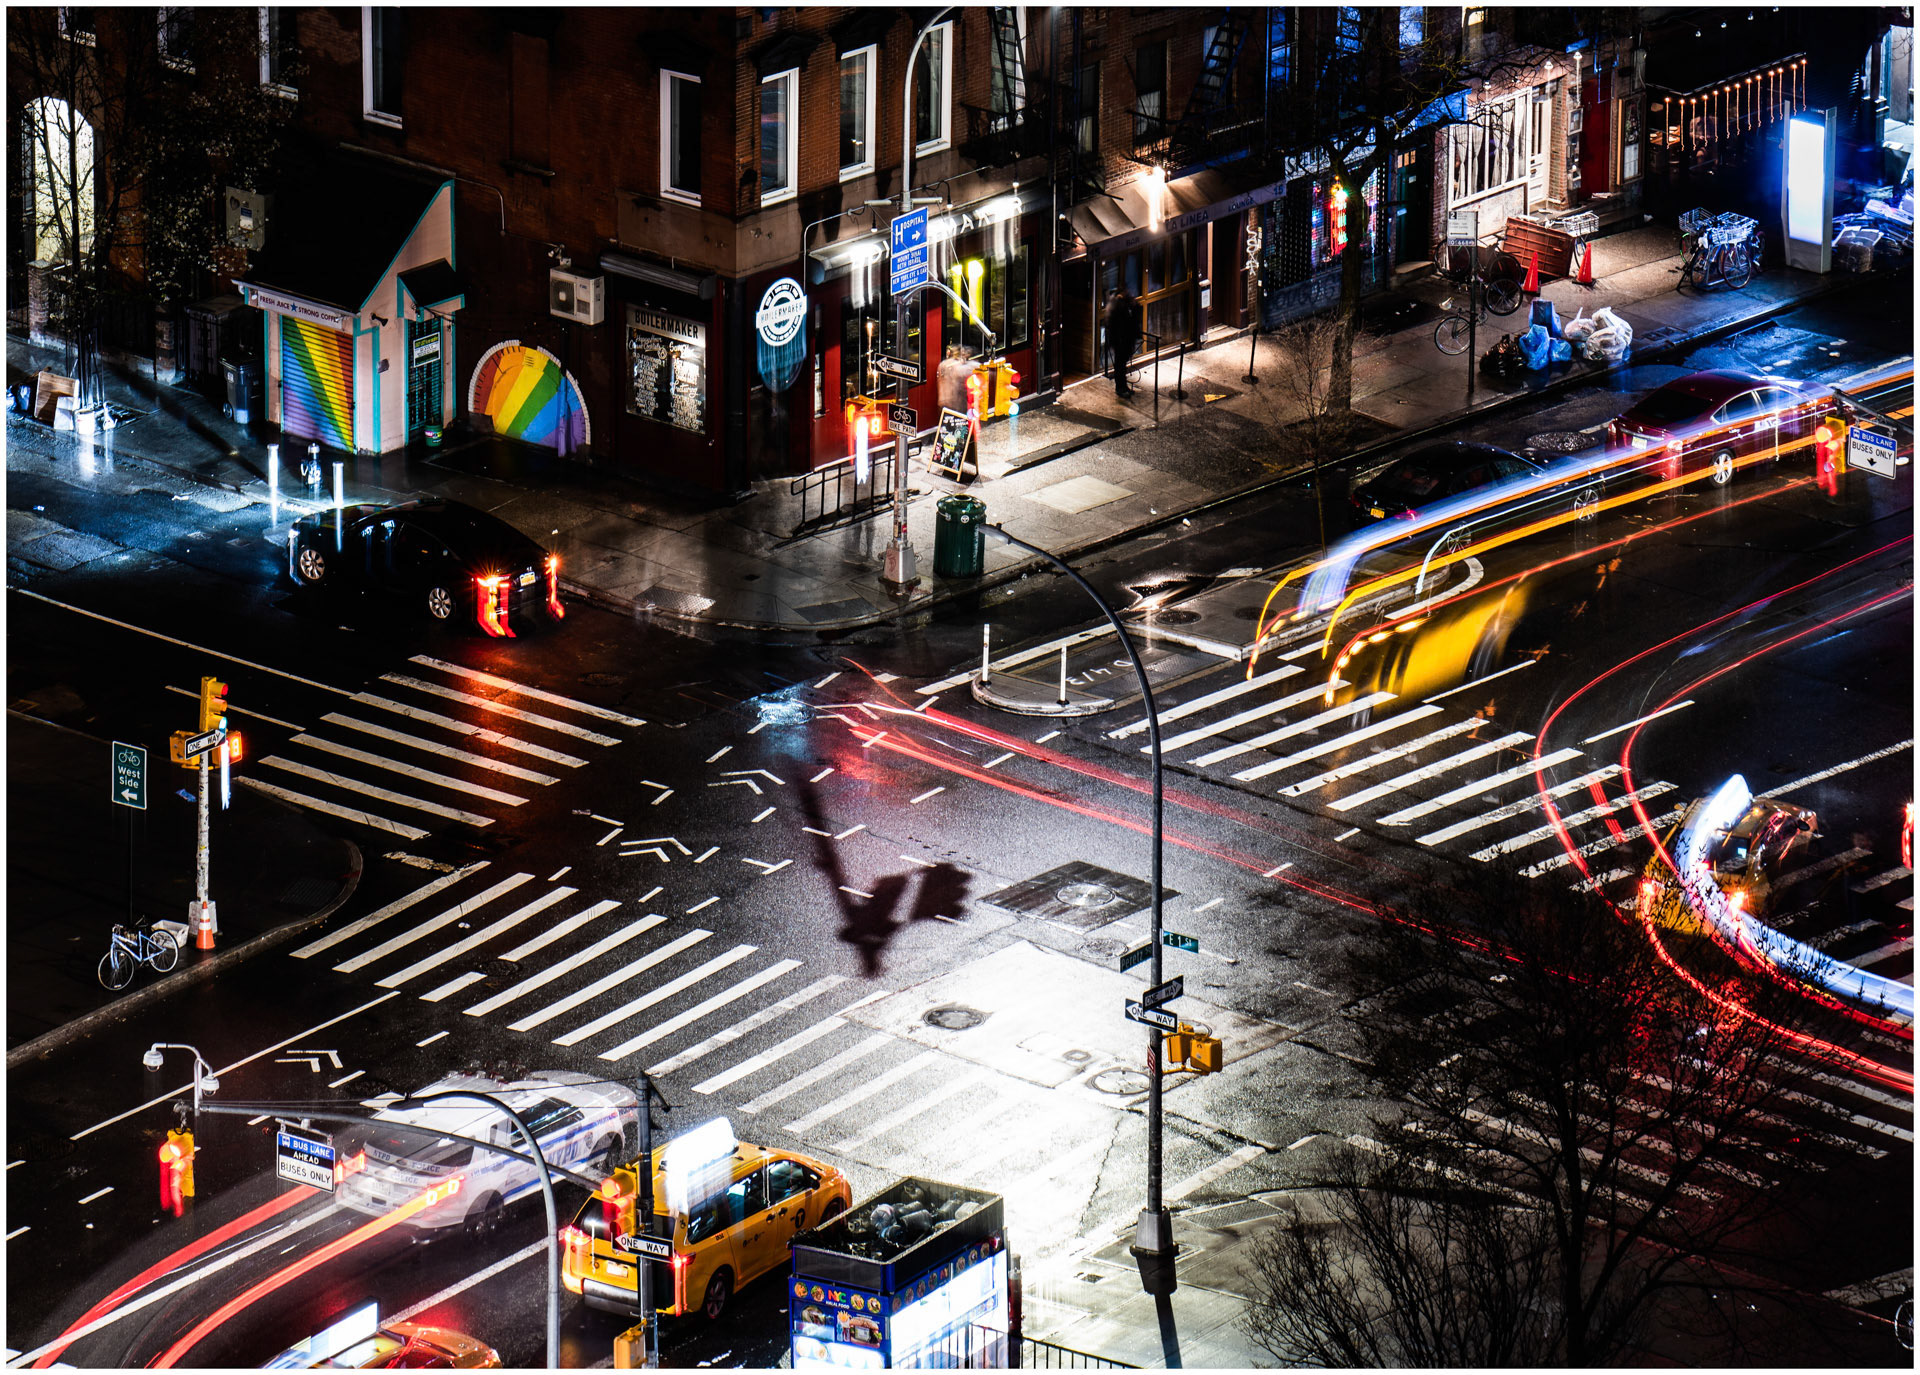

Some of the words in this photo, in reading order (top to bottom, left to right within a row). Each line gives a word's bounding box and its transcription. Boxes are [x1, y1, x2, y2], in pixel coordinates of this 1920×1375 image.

[1228, 197, 1255, 212] LOUNGE
[1165, 219, 1177, 232] LA
[1180, 211, 1209, 228] LINEA
[260, 295, 275, 305] FRESH
[276, 299, 290, 310] JUICE
[298, 307, 319, 318] STRONG
[635, 309, 699, 339] BOILERMAKER
[880, 360, 895, 371] ONE
[901, 365, 916, 375] WAY
[889, 421, 900, 431] BIKE
[902, 424, 914, 434] PATH
[1862, 433, 1874, 443] BUS
[1876, 437, 1893, 448] LANE
[1852, 441, 1873, 454] BUSES
[1875, 448, 1893, 460] ONLY
[188, 741, 201, 752] ONE
[207, 733, 220, 745] WAY
[117, 765, 140, 780] West
[119, 776, 138, 789] Side
[1169, 933, 1173, 946] E
[1146, 994, 1158, 1005] ONE
[1165, 984, 1178, 996] WAY
[1156, 1013, 1173, 1025] WAY
[293, 1140, 308, 1151] BUS
[310, 1145, 330, 1158] LANE
[373, 1149, 391, 1161] NYPD
[293, 1151, 319, 1165] AHEAD
[280, 1161, 307, 1177] BUSES
[310, 1170, 330, 1184] ONLY
[411, 1161, 441, 1173] POLICE
[620, 1236, 639, 1249] ONE
[646, 1242, 665, 1254] WAY
[828, 1289, 847, 1303] NYC
